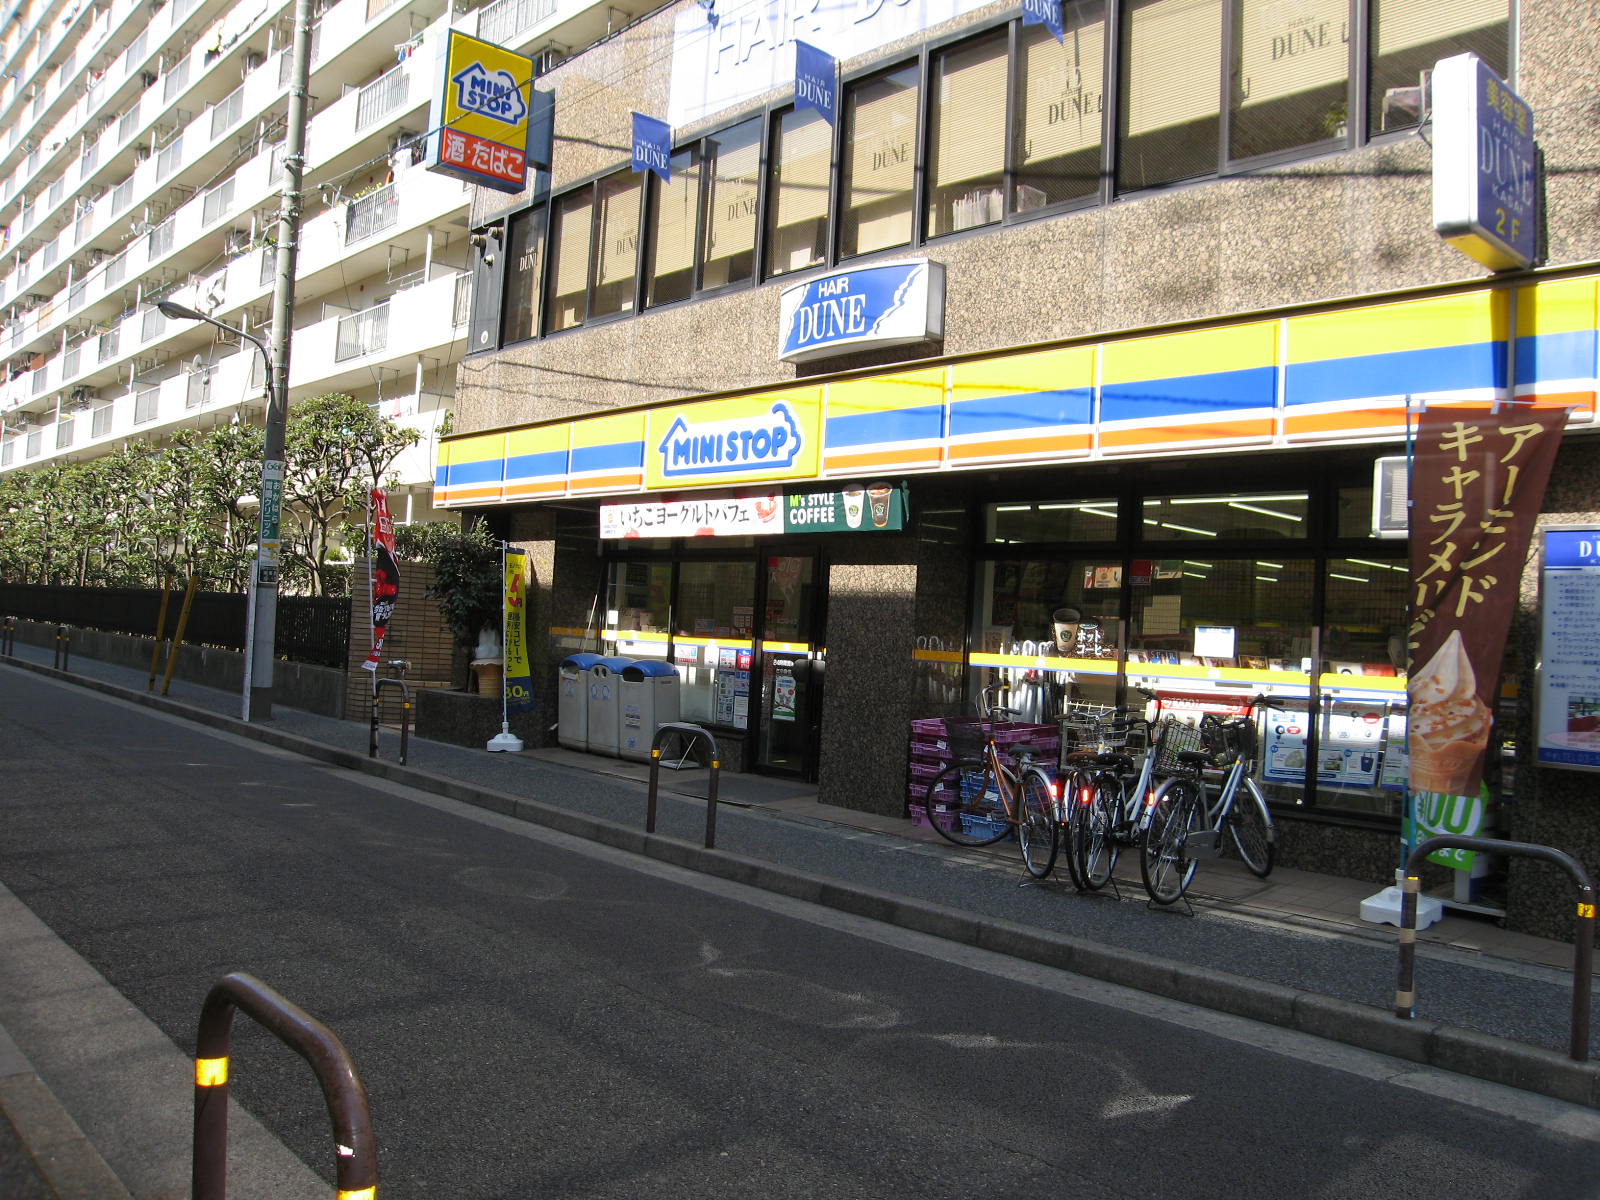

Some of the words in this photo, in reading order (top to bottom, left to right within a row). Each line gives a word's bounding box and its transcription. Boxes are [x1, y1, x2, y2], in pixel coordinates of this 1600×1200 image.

[1272, 22, 1330, 60] DUNE
[471, 75, 513, 101] MINI
[804, 74, 826, 87] HAIR
[467, 90, 513, 115] STOP
[798, 78, 832, 110] DUNE
[1049, 92, 1093, 124] DUNE
[445, 131, 523, 179] 酒・たばこ
[635, 145, 668, 170] DUNE
[872, 142, 909, 171] DUNE
[1480, 124, 1532, 206] DUNE
[1495, 207, 1521, 244] 2F
[818, 276, 849, 298] HAIR
[798, 294, 866, 344] DUNE
[673, 426, 788, 466] MINISTOP
[808, 492, 835, 506] STYLE
[620, 502, 750, 528] いちごヨーグルトパフェ
[789, 507, 835, 525] COFFEE
[1076, 643, 1111, 656] コーヒー
[1077, 629, 1101, 644] ホット
